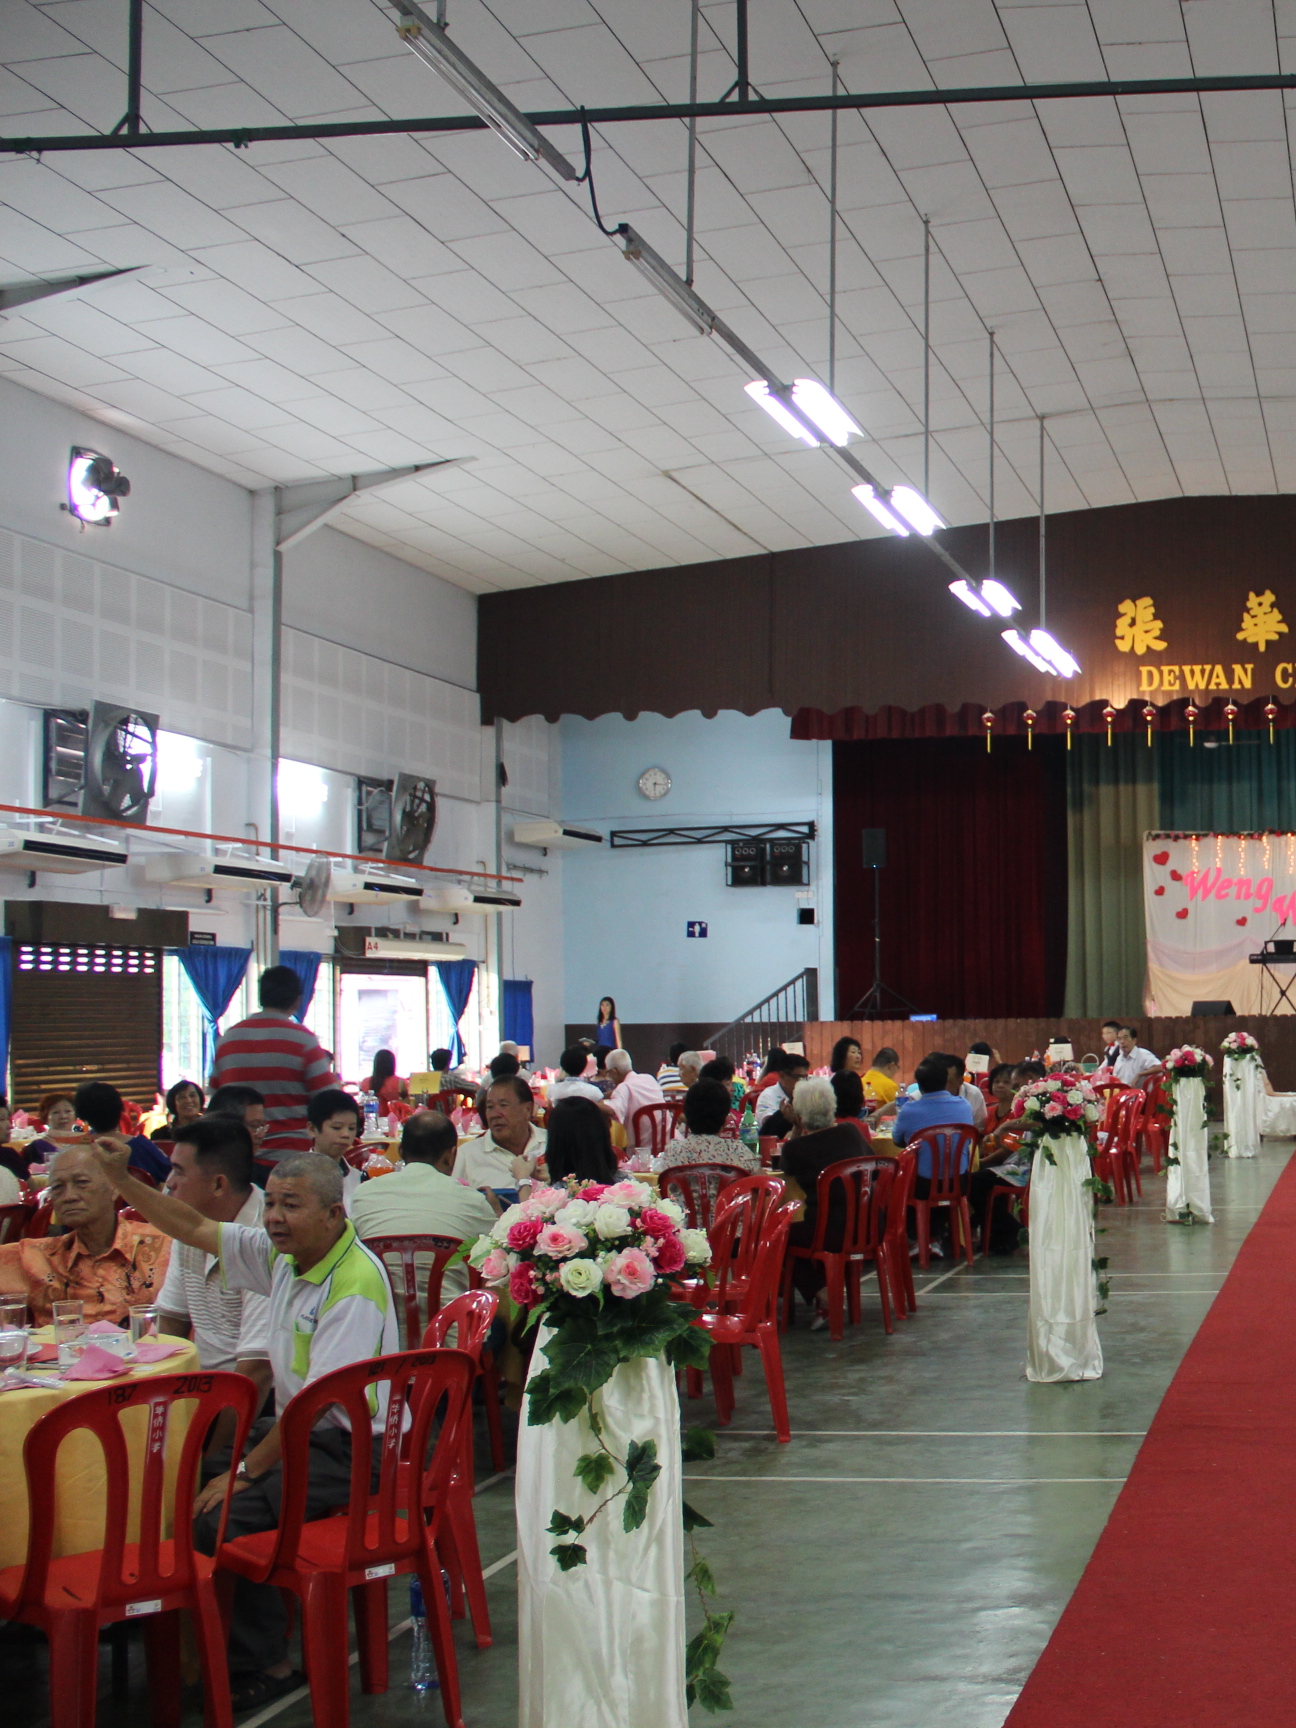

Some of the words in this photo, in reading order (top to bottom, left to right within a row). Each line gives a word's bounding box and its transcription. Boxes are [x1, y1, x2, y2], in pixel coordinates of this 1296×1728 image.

[1139, 663, 1255, 691] DEWAN
[1182, 867, 1274, 914] Weng
[107, 1383, 139, 1406] 187
[172, 1375, 215, 1395] 2013
